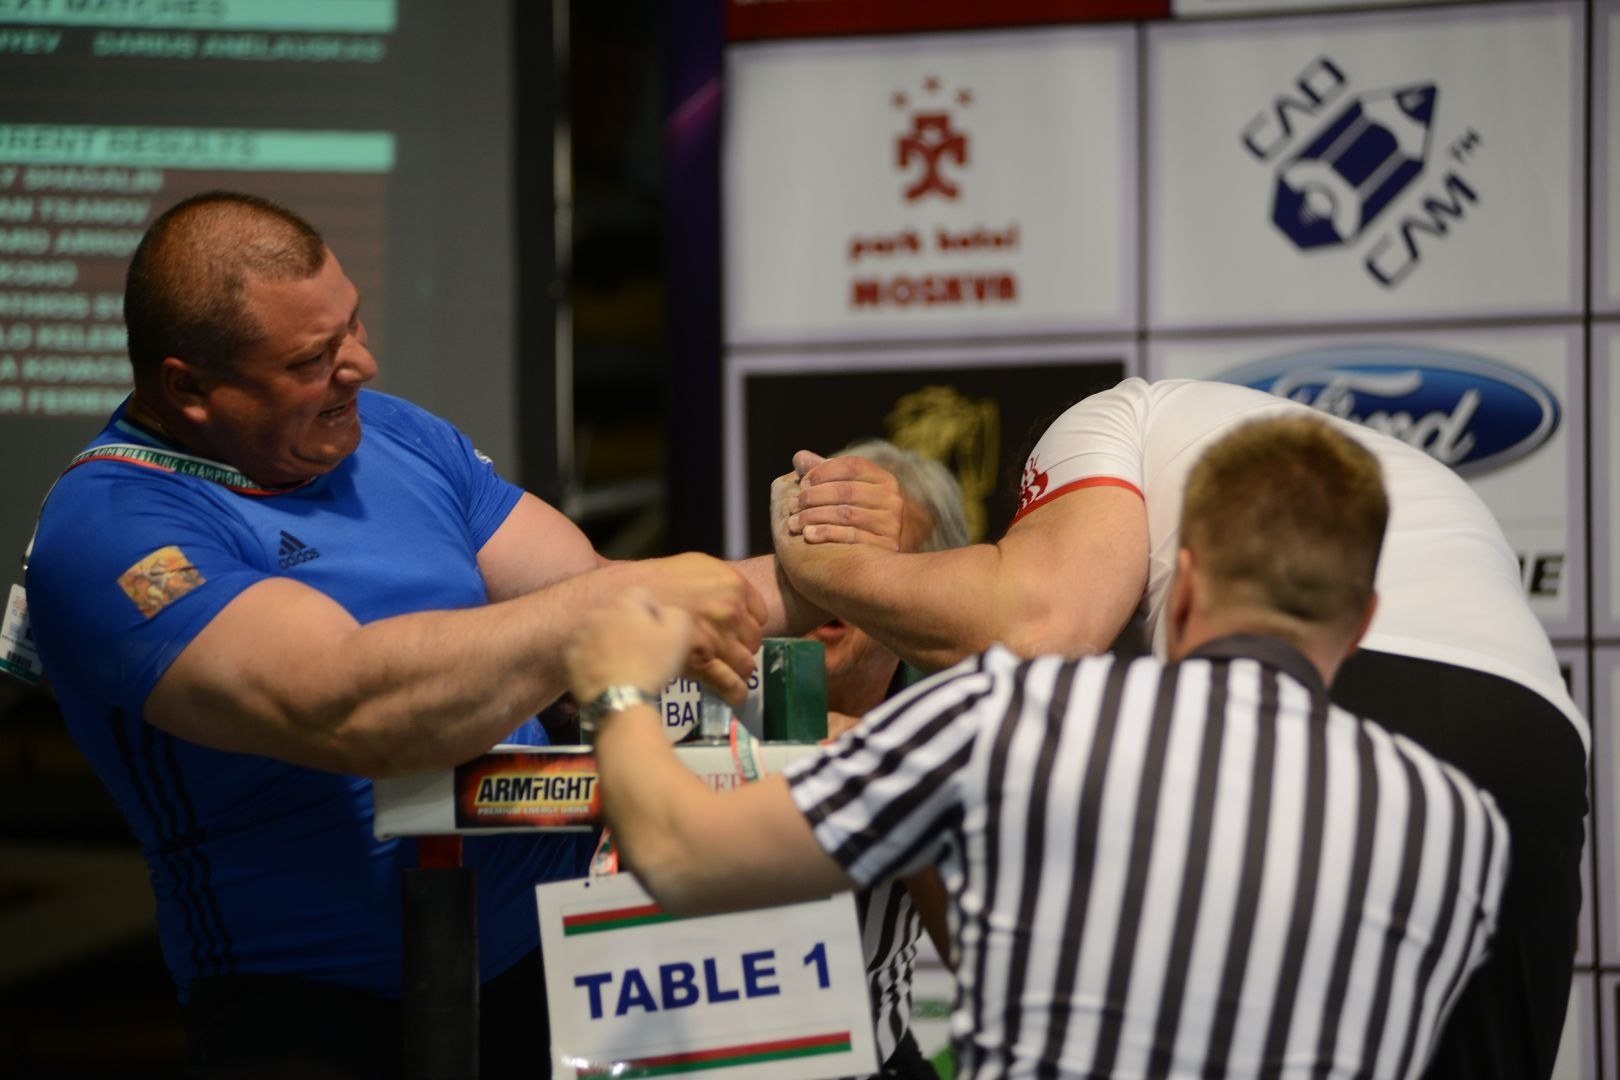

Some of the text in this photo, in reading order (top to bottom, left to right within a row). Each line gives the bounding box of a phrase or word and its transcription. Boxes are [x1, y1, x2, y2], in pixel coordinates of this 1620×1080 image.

[477, 776, 596, 802] ARMFIGHT
[574, 943, 831, 1020] TABLE 1
